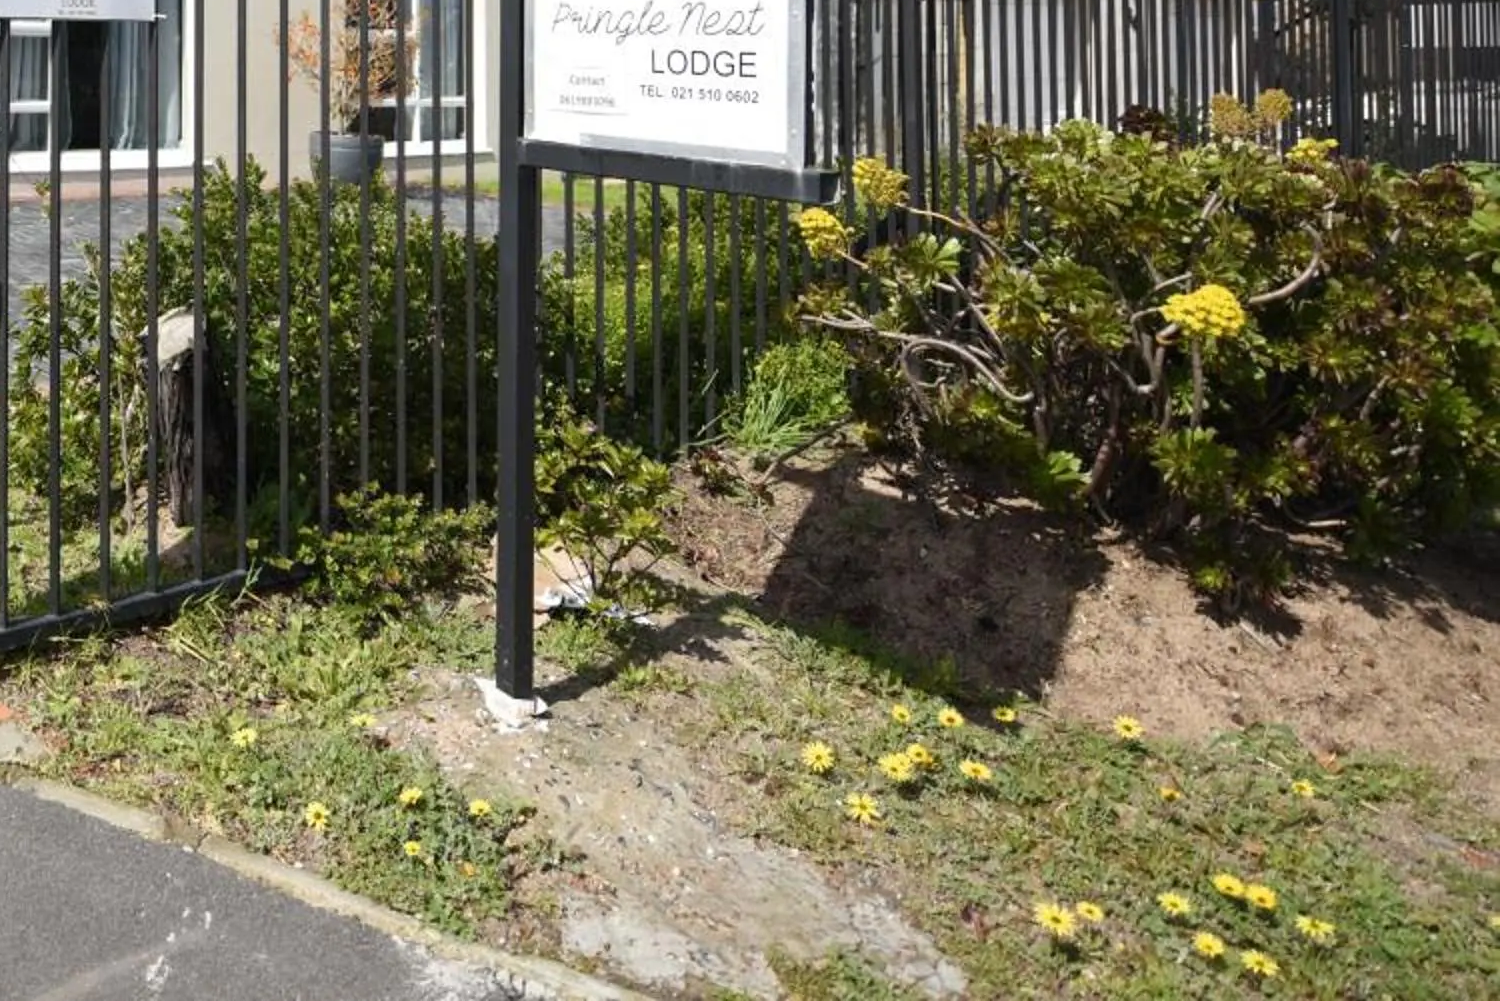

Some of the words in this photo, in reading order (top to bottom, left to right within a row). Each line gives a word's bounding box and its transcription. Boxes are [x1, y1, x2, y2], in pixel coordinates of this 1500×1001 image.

[650, 48, 758, 79] LODGE
[568, 73, 606, 87] Contact
[671, 86, 694, 100] 021
[698, 88, 722, 102] 510
[725, 89, 760, 104] 0602
